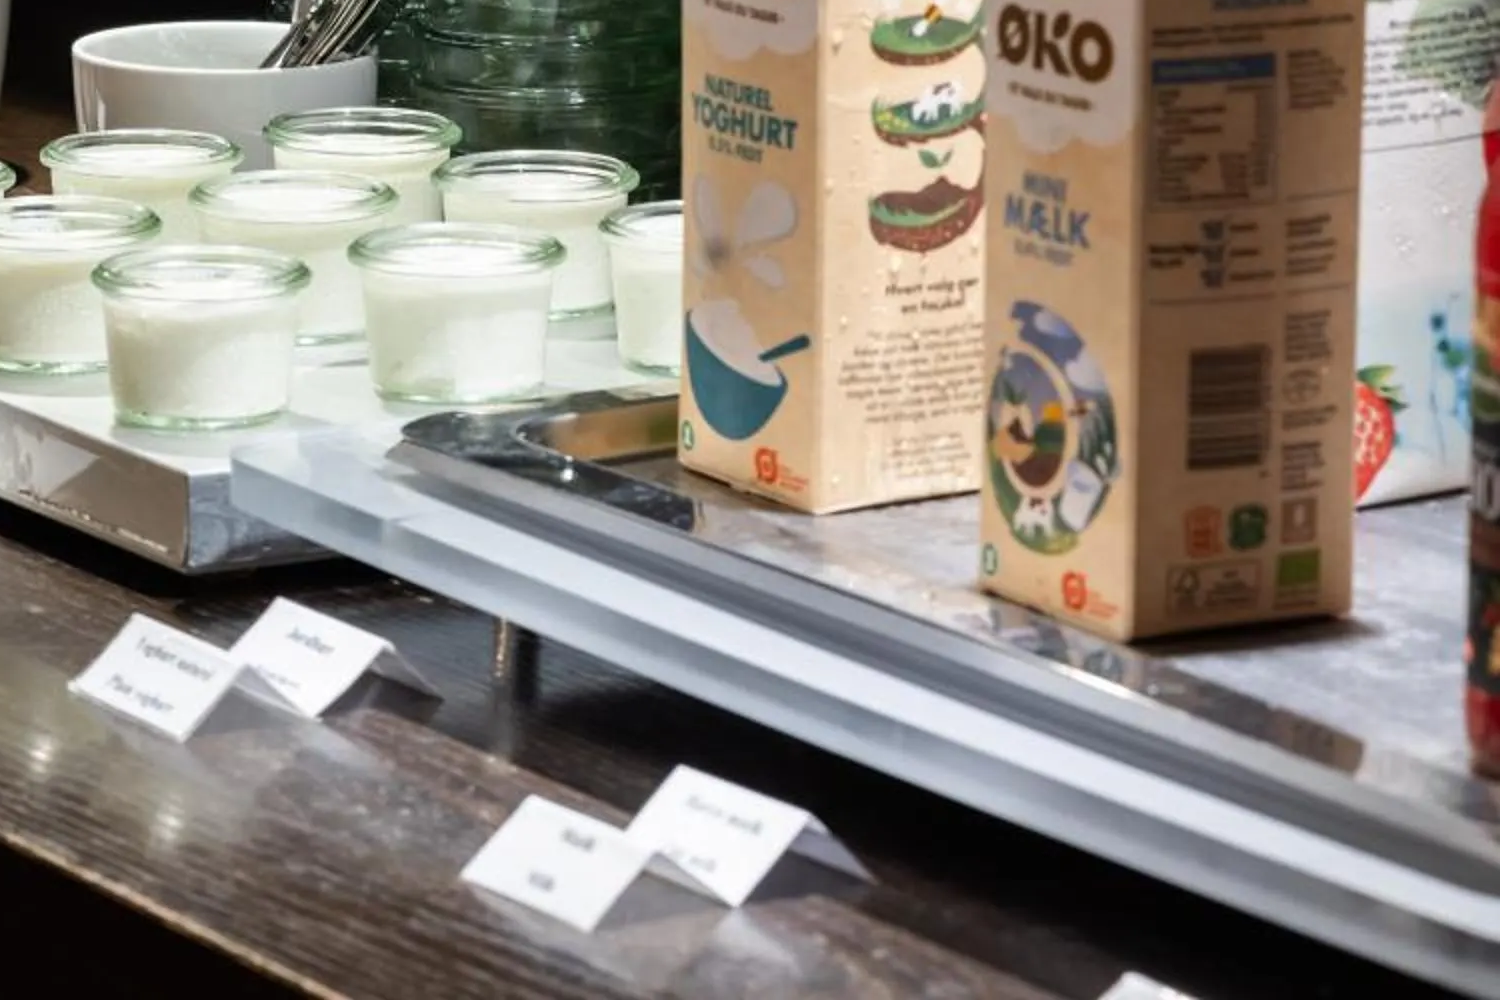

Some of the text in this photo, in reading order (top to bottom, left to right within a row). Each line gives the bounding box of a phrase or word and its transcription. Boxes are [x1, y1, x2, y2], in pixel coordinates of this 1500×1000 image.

[997, 3, 1115, 84] ØKO
[705, 72, 773, 112] NATUREL
[692, 92, 798, 151] YOGHURT
[1004, 193, 1092, 251] MÆLK
